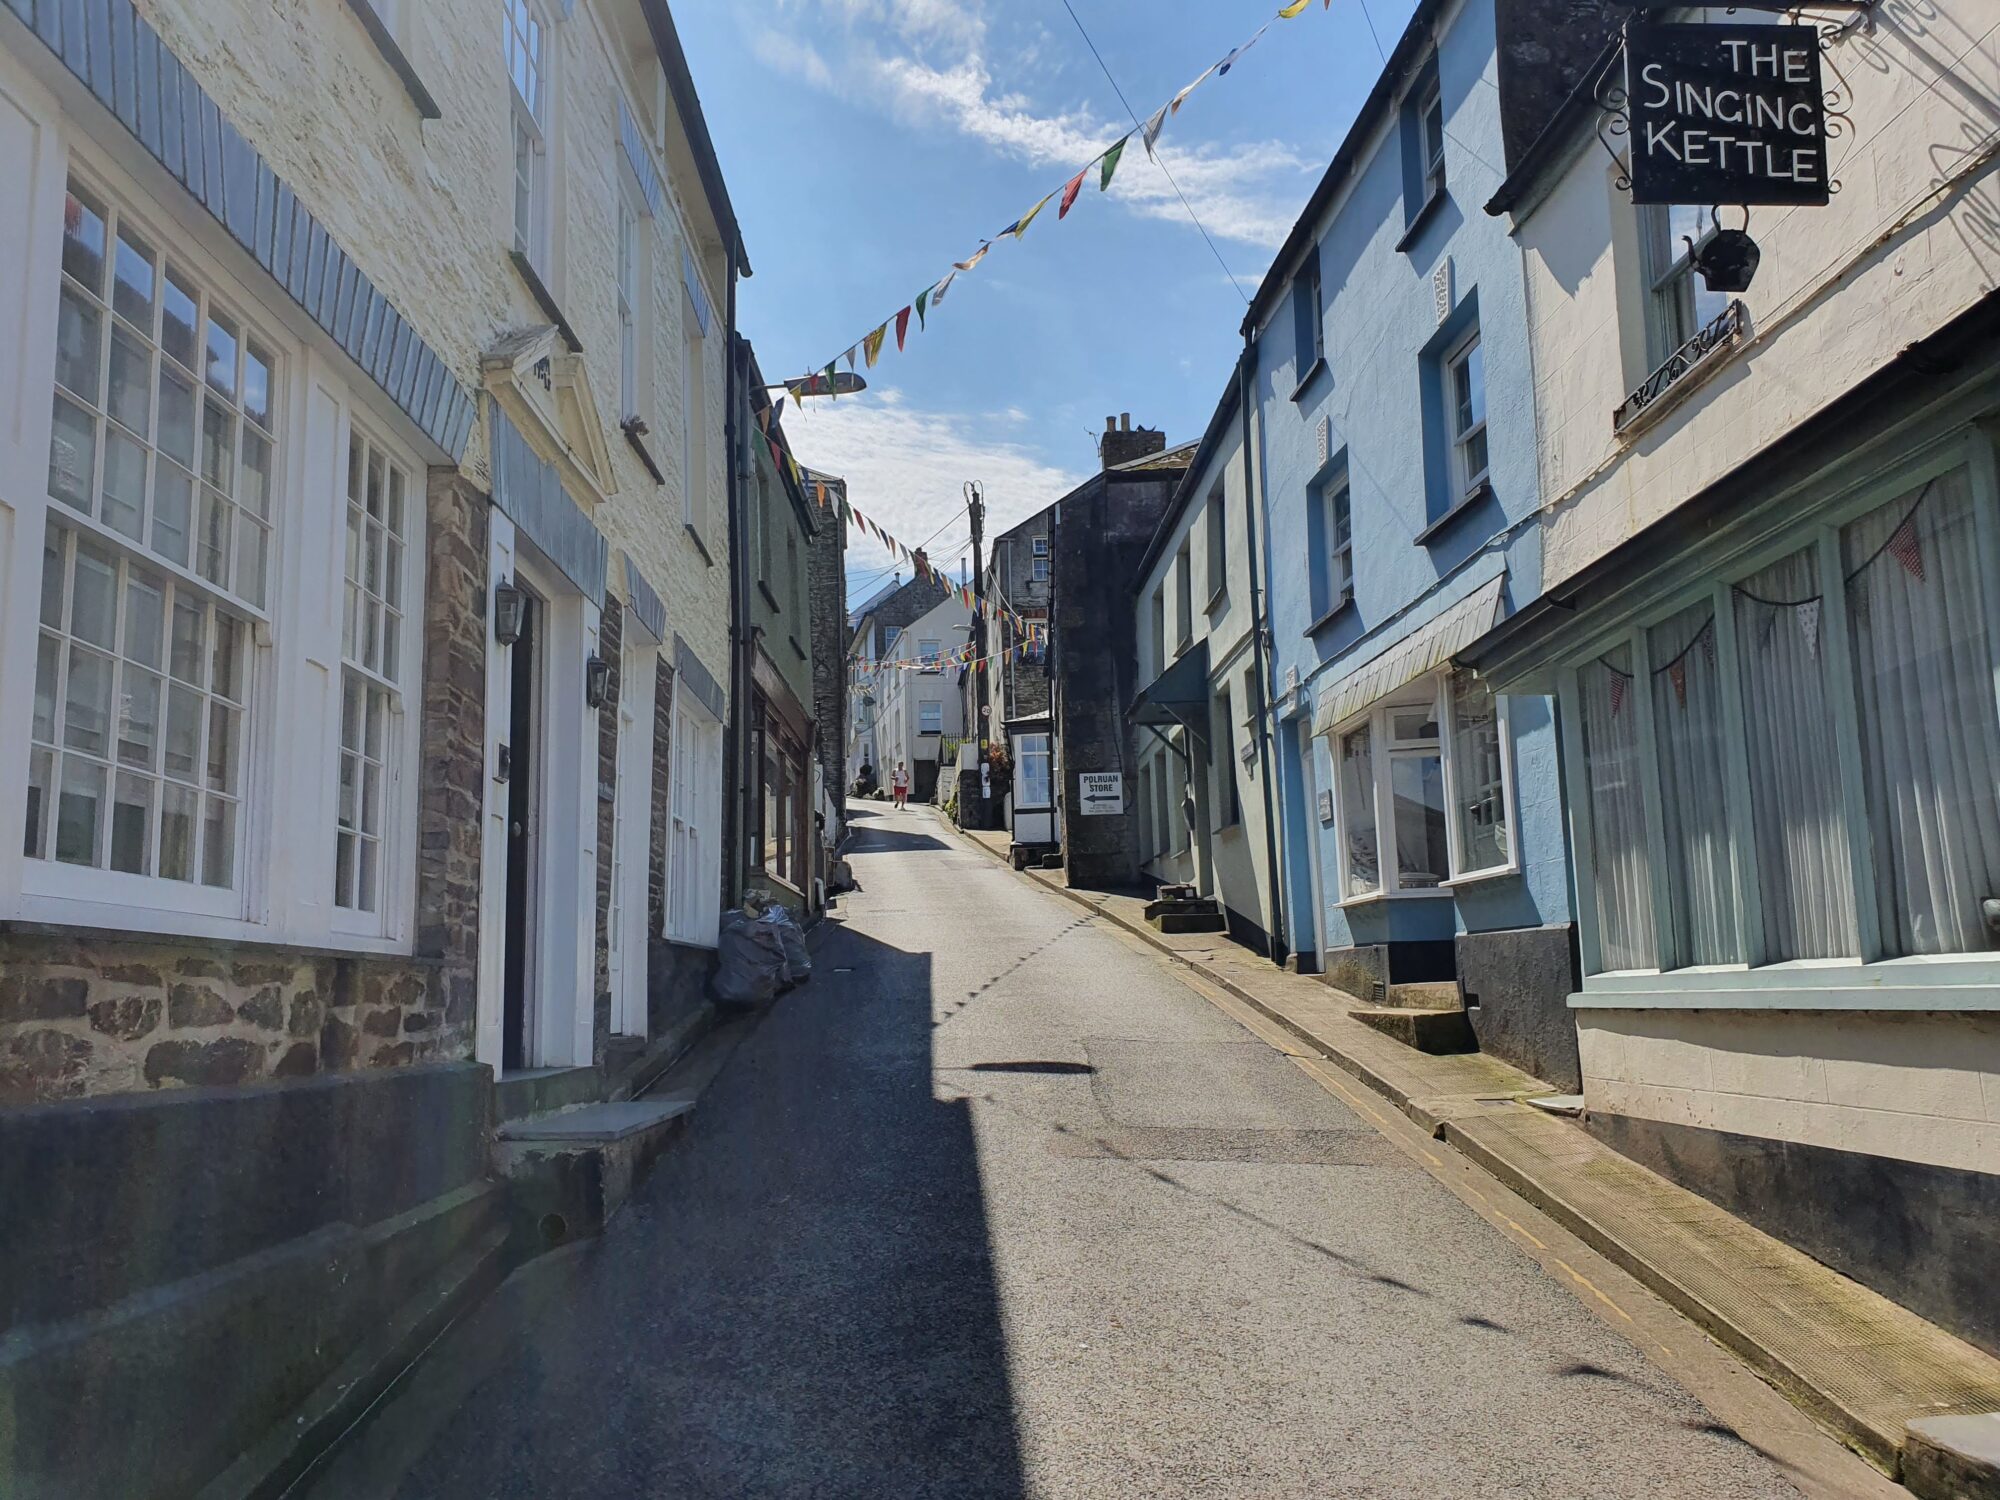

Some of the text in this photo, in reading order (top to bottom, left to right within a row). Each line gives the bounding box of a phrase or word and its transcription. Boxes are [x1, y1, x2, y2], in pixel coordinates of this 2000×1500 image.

[1721, 40, 1811, 82] THE
[1641, 63, 1817, 136] SINGING
[1647, 120, 1818, 182] KETTLE
[1083, 775, 1118, 783] POLRUAN
[1089, 784, 1113, 792] STORE
